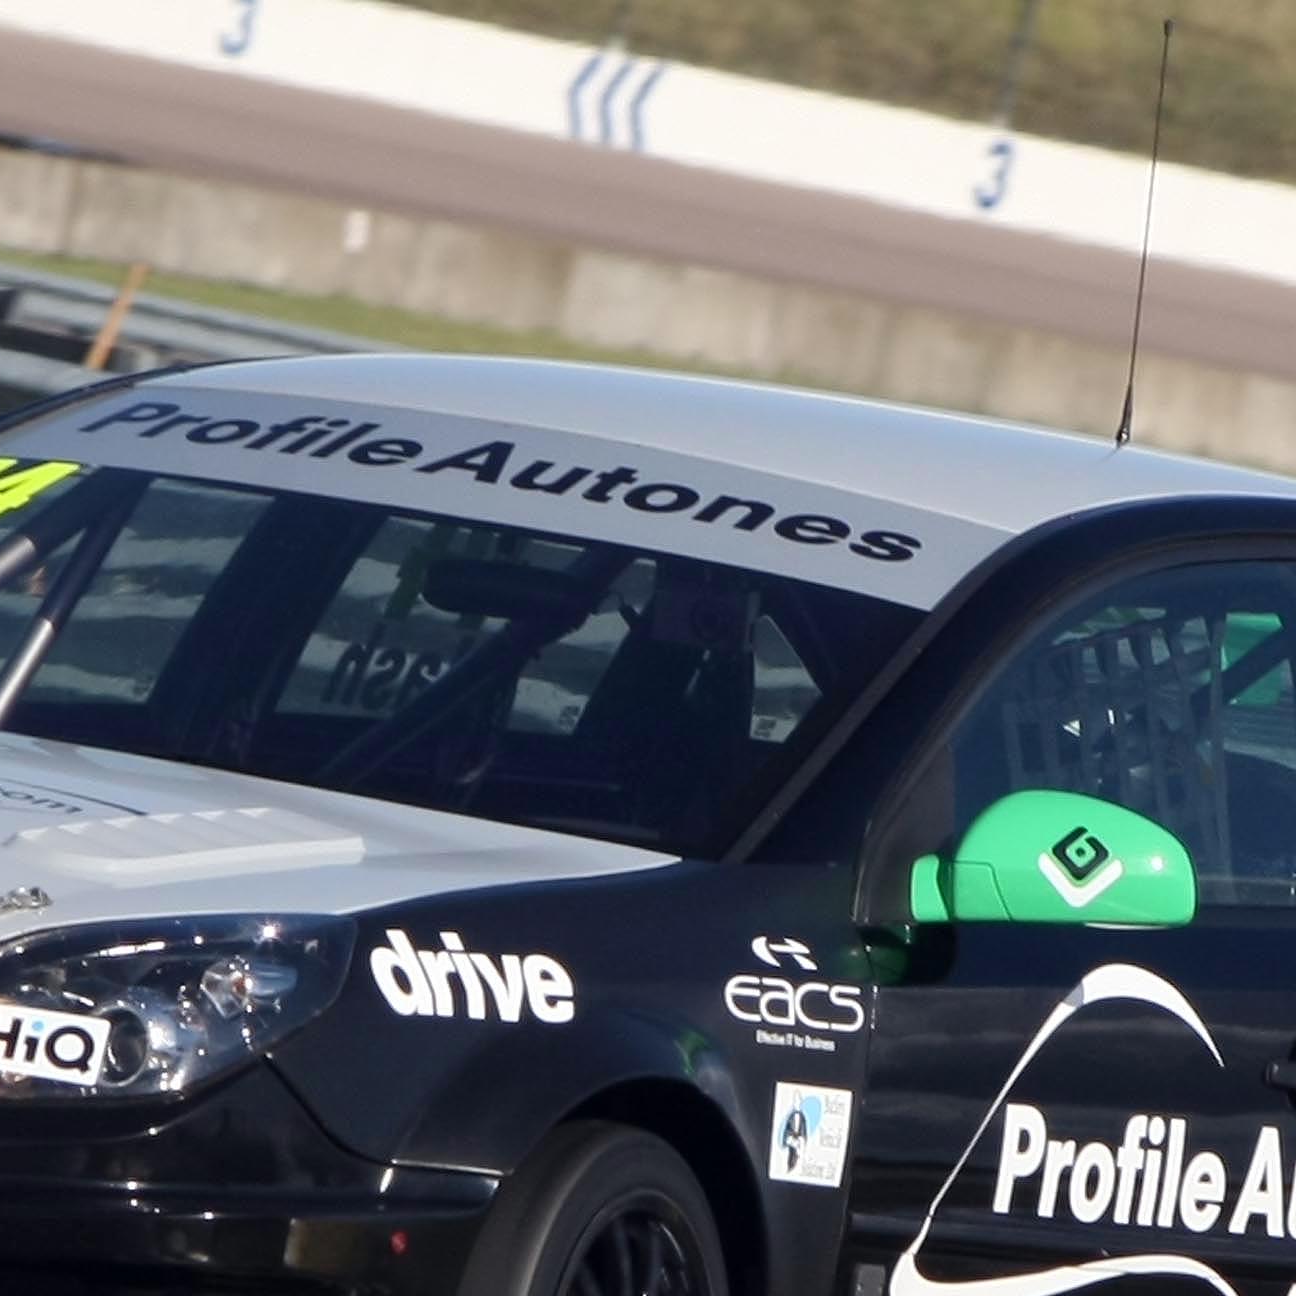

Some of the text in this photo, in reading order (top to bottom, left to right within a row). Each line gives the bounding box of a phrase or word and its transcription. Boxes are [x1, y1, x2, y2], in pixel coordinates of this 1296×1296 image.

[972, 142, 1013, 210] 3
[79, 402, 923, 563] Profile Autones
[369, 928, 576, 1024] drive
[992, 1101, 1227, 1233] Profile
